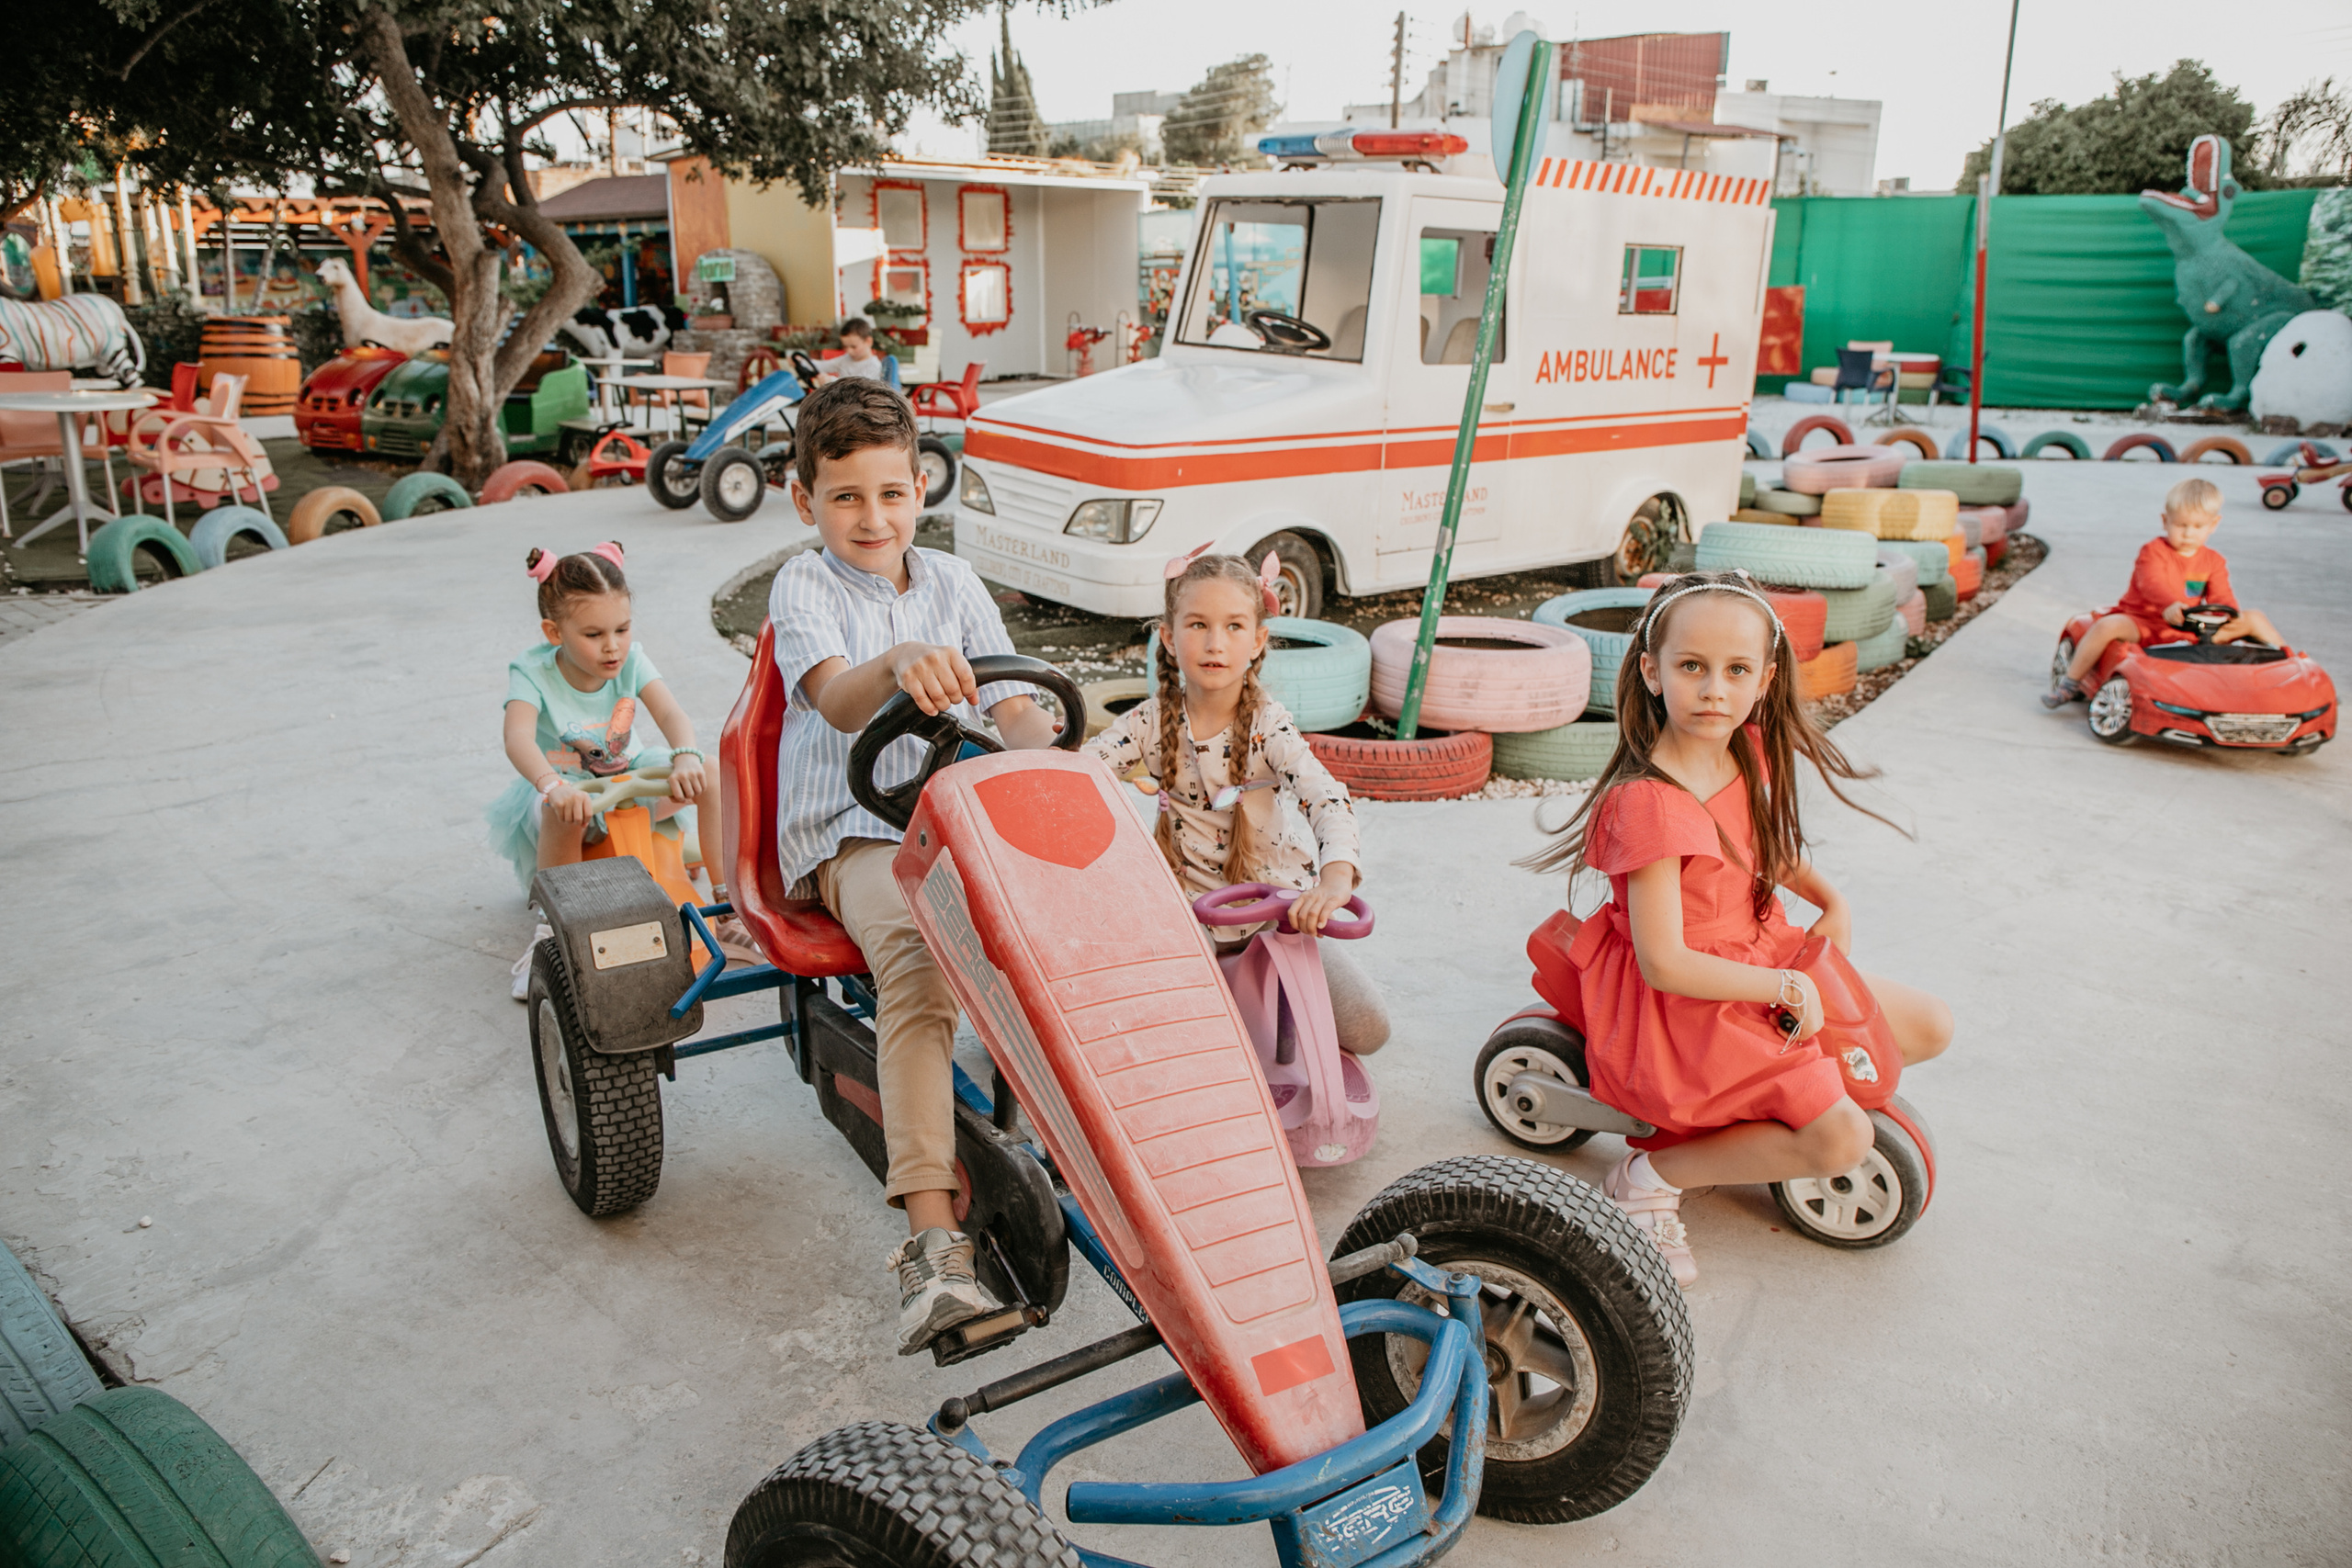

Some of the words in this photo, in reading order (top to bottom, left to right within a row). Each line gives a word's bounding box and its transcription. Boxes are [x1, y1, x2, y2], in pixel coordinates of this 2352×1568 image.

[1535, 348, 1678, 383] AMBULANCE
[1401, 487, 1488, 512] MASTEAND
[976, 525, 1070, 569] MASTERLAND
[927, 868, 995, 993] BERG
